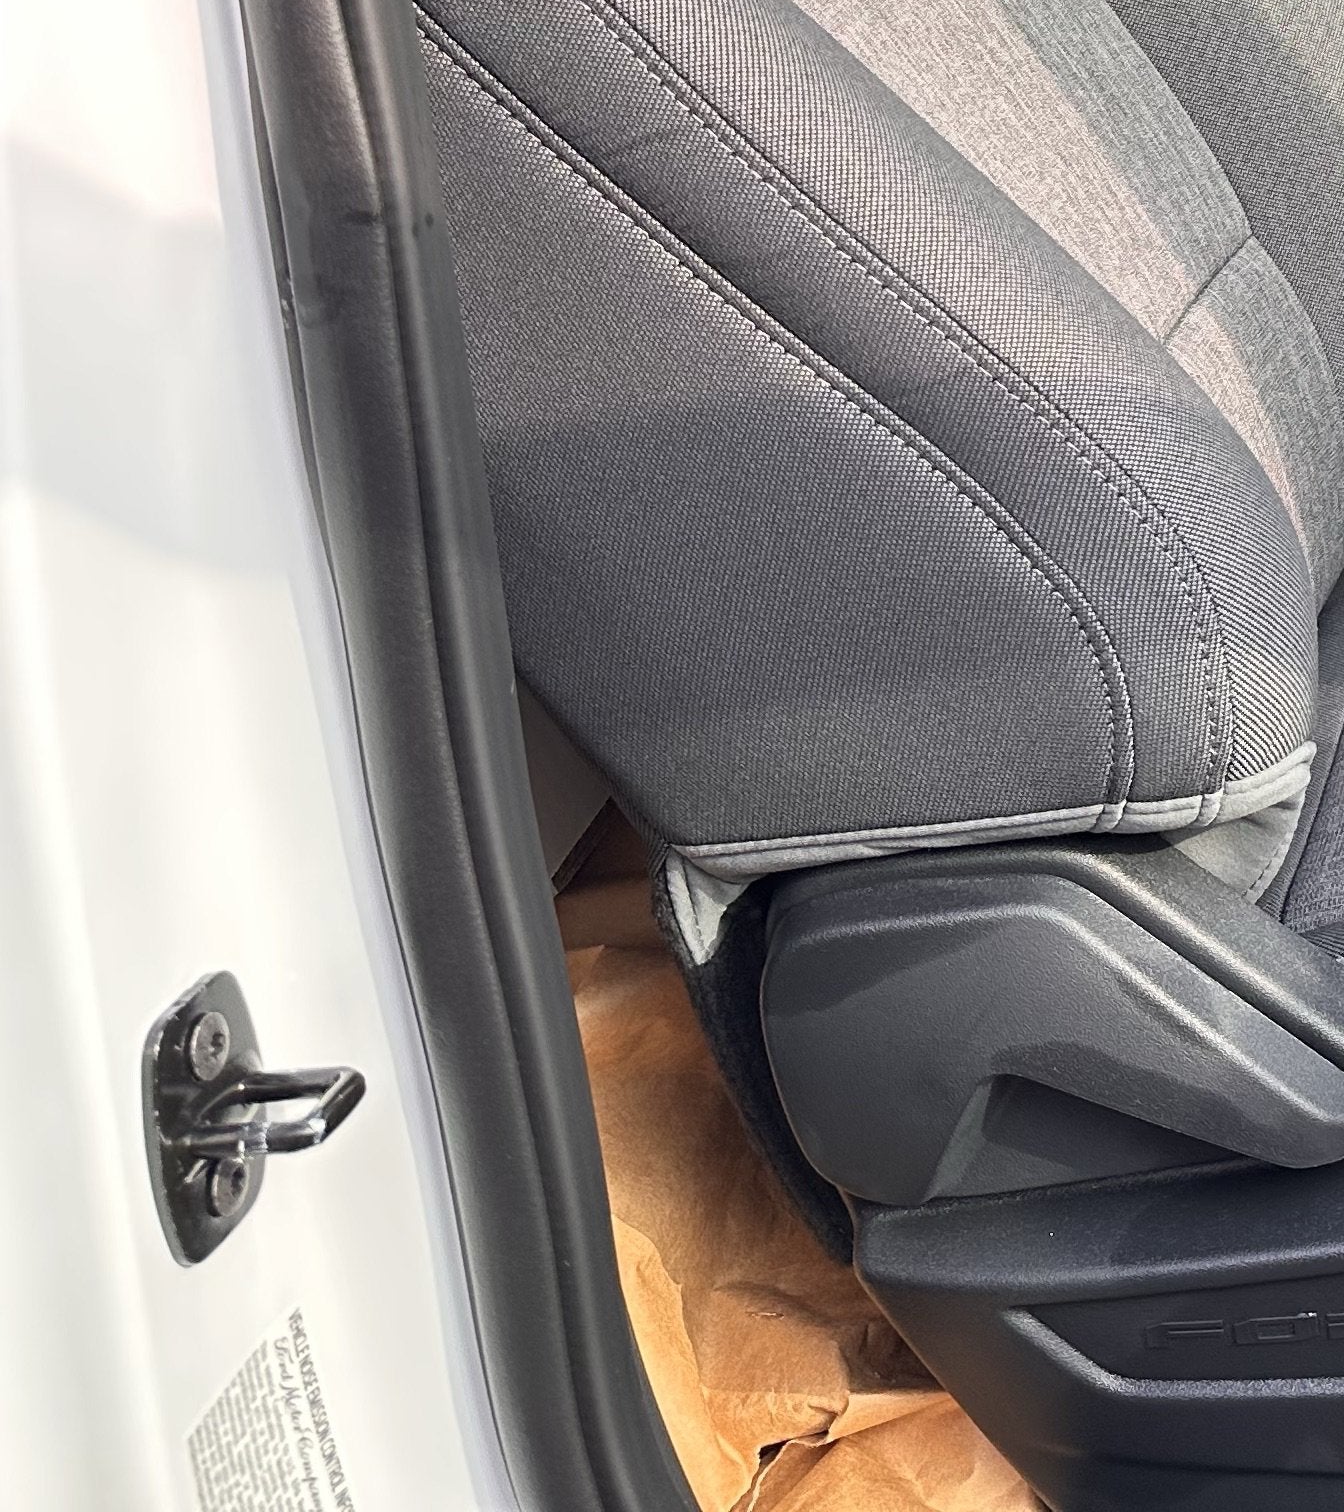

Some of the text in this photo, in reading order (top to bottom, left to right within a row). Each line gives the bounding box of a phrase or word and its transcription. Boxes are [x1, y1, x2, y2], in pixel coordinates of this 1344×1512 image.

[289, 1306, 310, 1359] VEHICLE
[274, 1336, 294, 1383] Ford
[299, 1353, 319, 1392] NOISE
[279, 1382, 313, 1435] Motor
[306, 1385, 331, 1444] EMISSION
[320, 1437, 346, 1493] CONTROL
